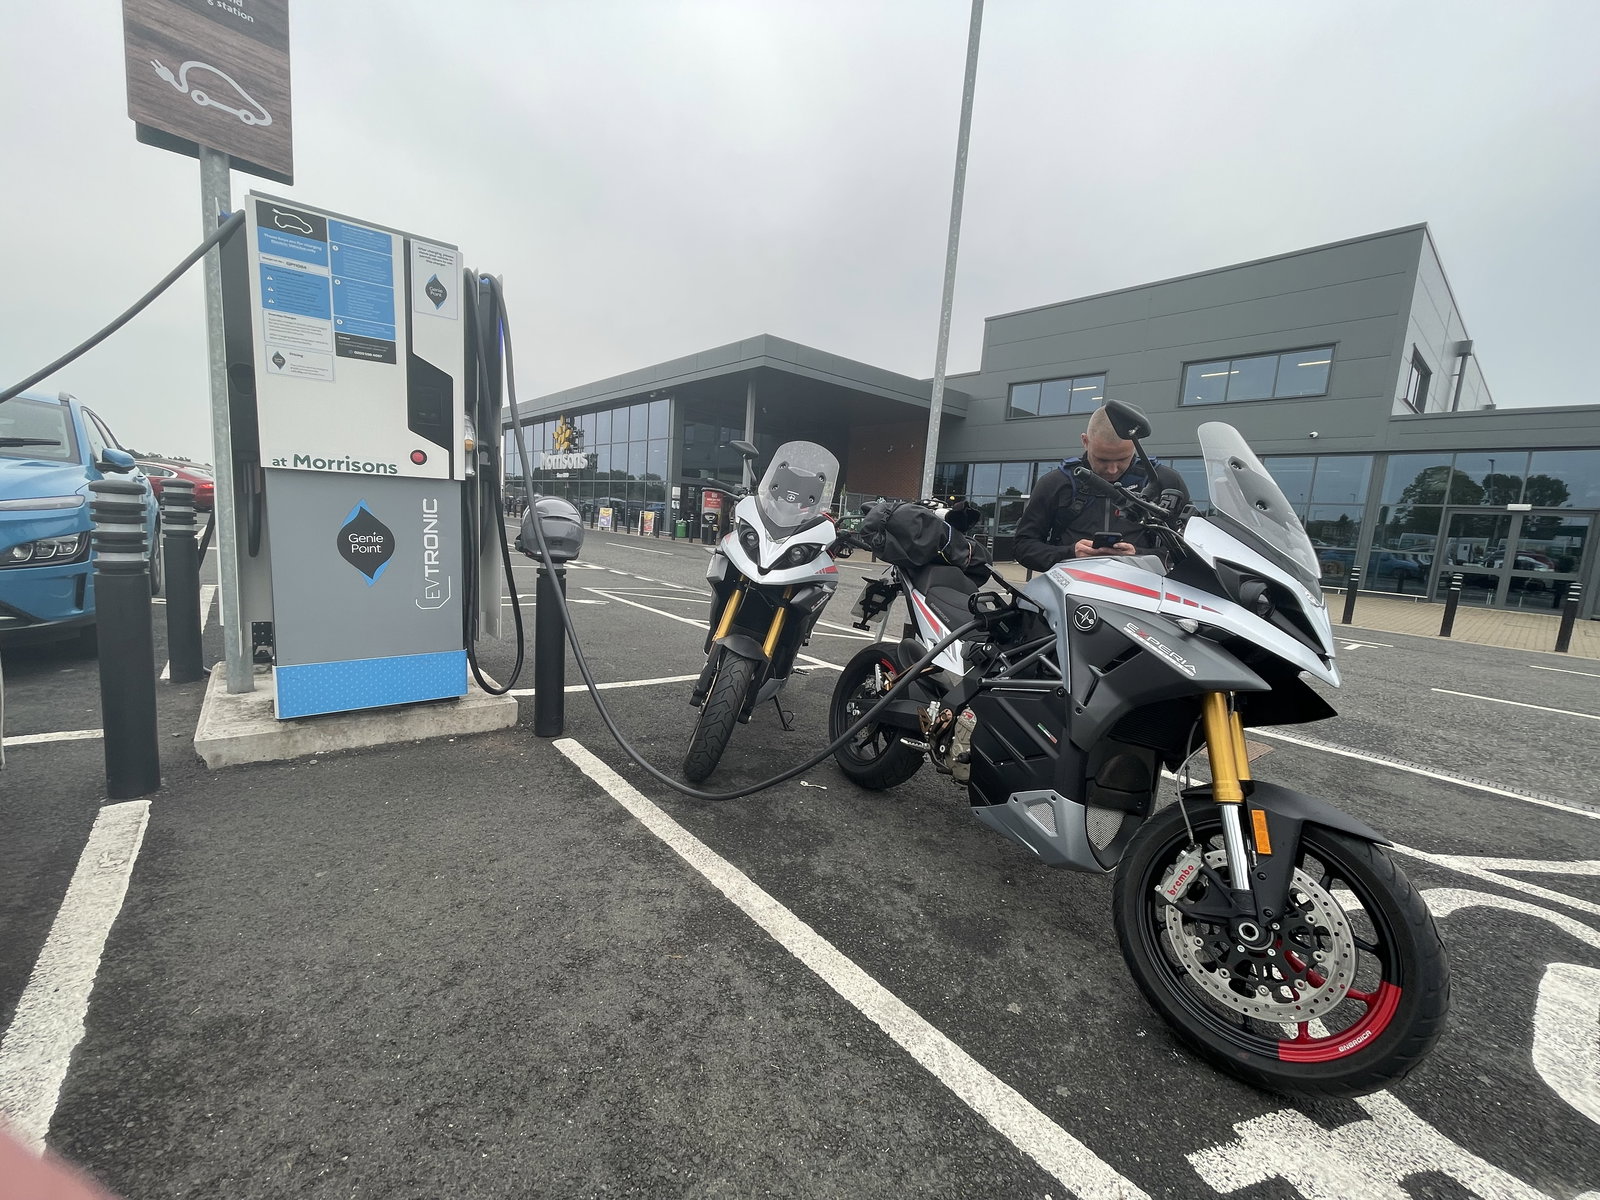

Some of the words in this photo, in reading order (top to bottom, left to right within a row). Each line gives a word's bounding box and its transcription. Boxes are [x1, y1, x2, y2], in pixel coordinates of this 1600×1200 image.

[216, 1, 254, 23] station
[272, 457, 287, 467] at
[293, 453, 398, 475] Morrisons
[348, 531, 384, 543] Genie
[351, 543, 382, 554] Point
[422, 498, 441, 599] EVTRONIC
[1126, 622, 1197, 674] EXPERIA
[1167, 865, 1194, 896] brembo
